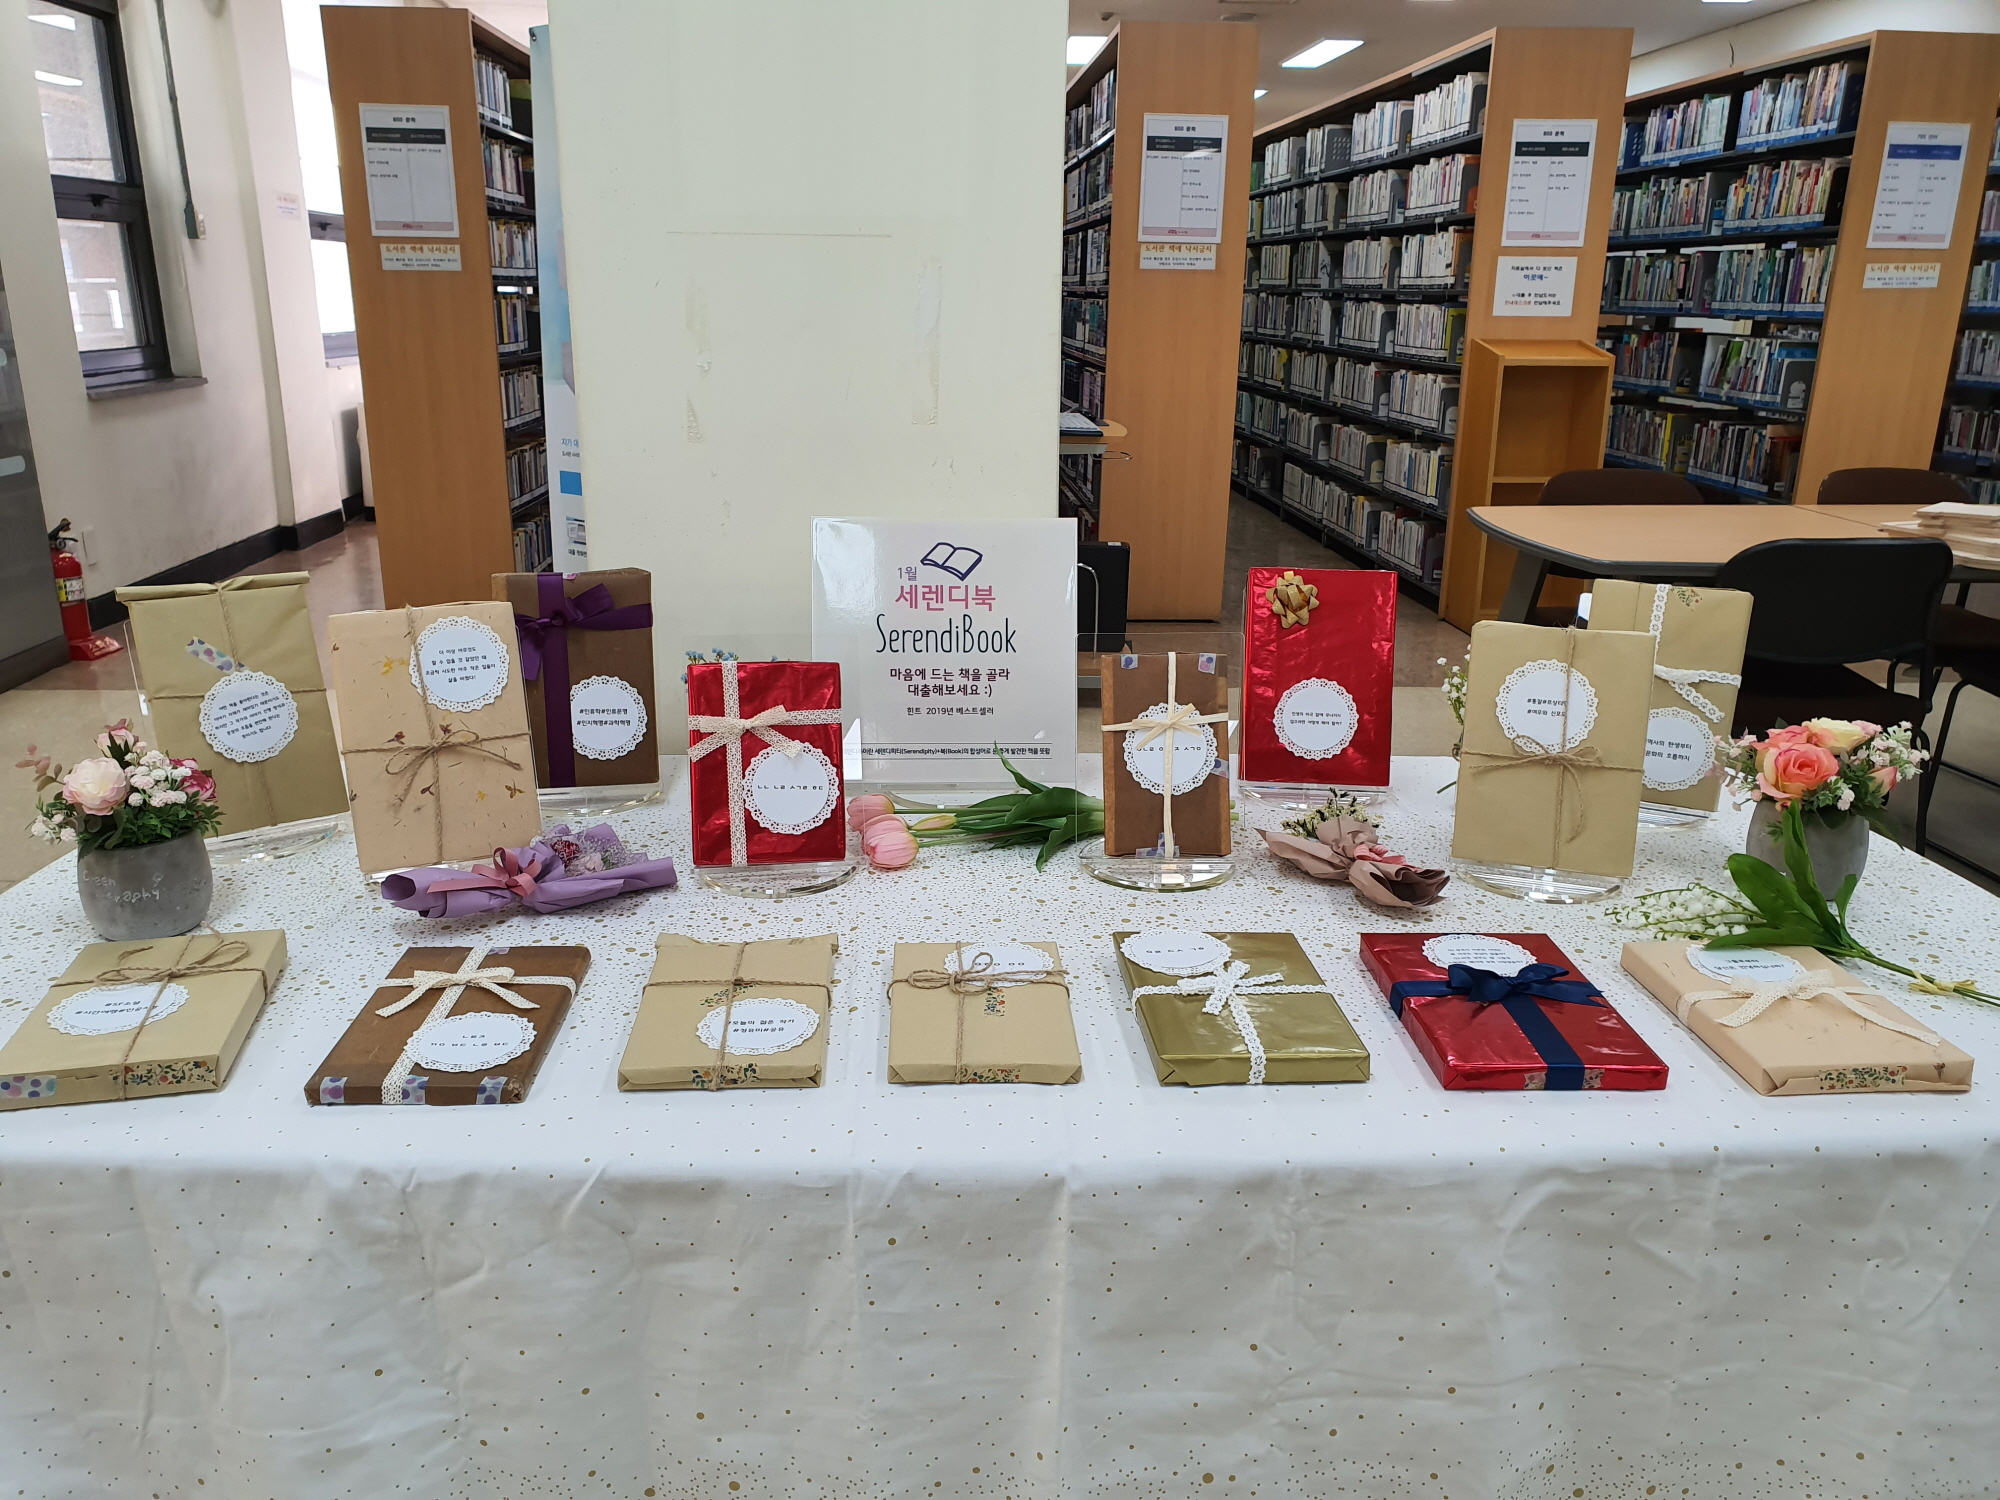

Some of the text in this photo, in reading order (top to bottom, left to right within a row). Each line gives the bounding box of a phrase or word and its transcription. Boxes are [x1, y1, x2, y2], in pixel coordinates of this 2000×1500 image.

[384, 245, 406, 254] 도서관
[1145, 244, 1212, 254] 도서관 책에 낙서금지
[897, 566, 918, 582] 1월
[895, 584, 996, 612] 세렌디북
[876, 614, 1016, 654] SerendiBook
[890, 668, 1010, 681] 마음에 드는 책을 골라
[908, 684, 980, 698] 대출해보세요
[906, 706, 994, 716] 힌트 2019년 베스트셀러
